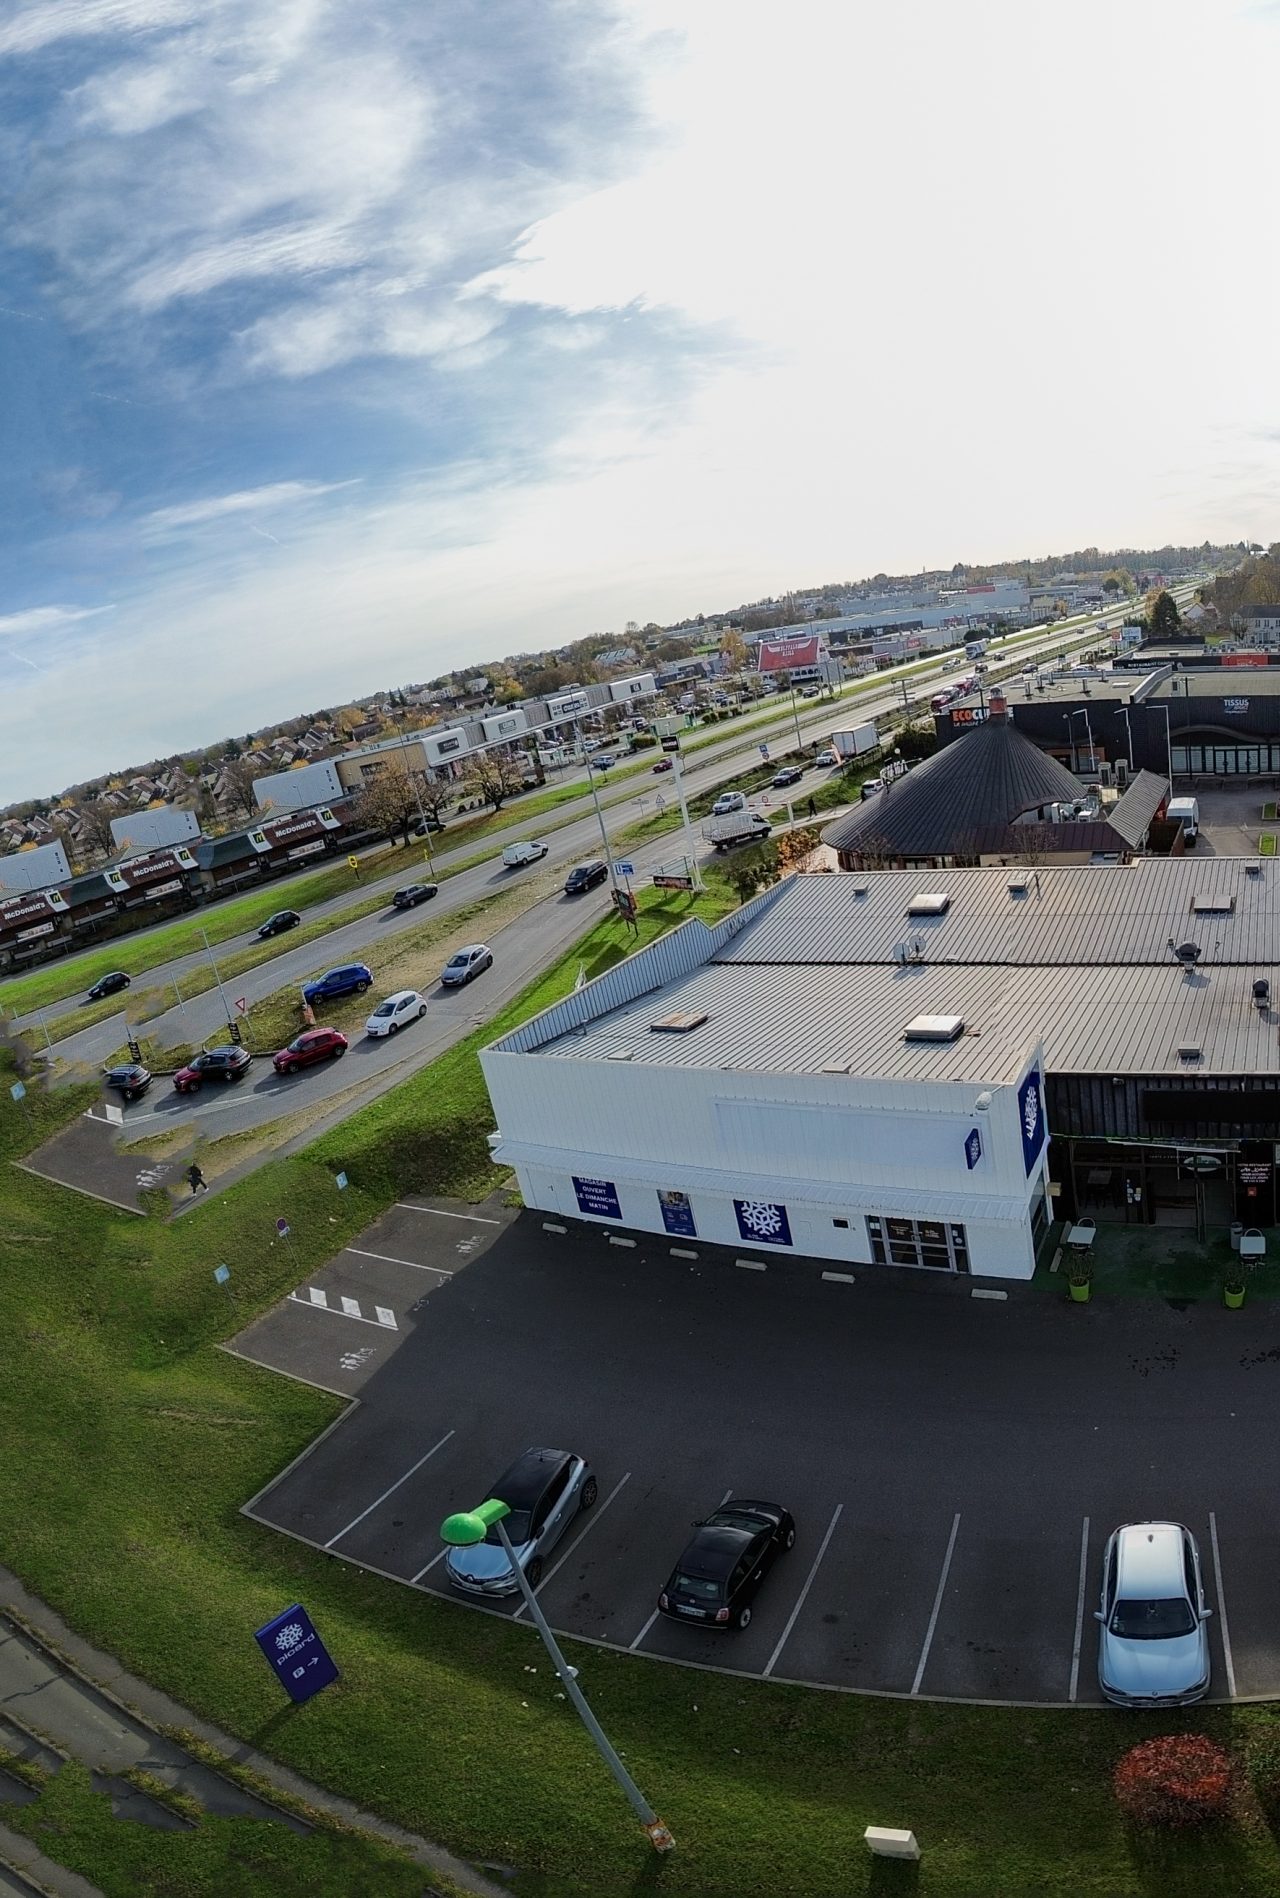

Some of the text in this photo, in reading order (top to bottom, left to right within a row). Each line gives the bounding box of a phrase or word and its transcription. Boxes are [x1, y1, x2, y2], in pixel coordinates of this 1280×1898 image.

[1224, 699, 1250, 707] TISSUS
[275, 819, 317, 838] McDonald's
[133, 859, 175, 878] McDonald's
[4, 902, 46, 920] McDonald's
[578, 1177, 607, 1187] MAGASIN
[582, 1186, 607, 1195] OUVERT
[585, 1194, 618, 1205] DIMANCHE
[588, 1202, 609, 1211] MATIN
[277, 1632, 316, 1666] picard
